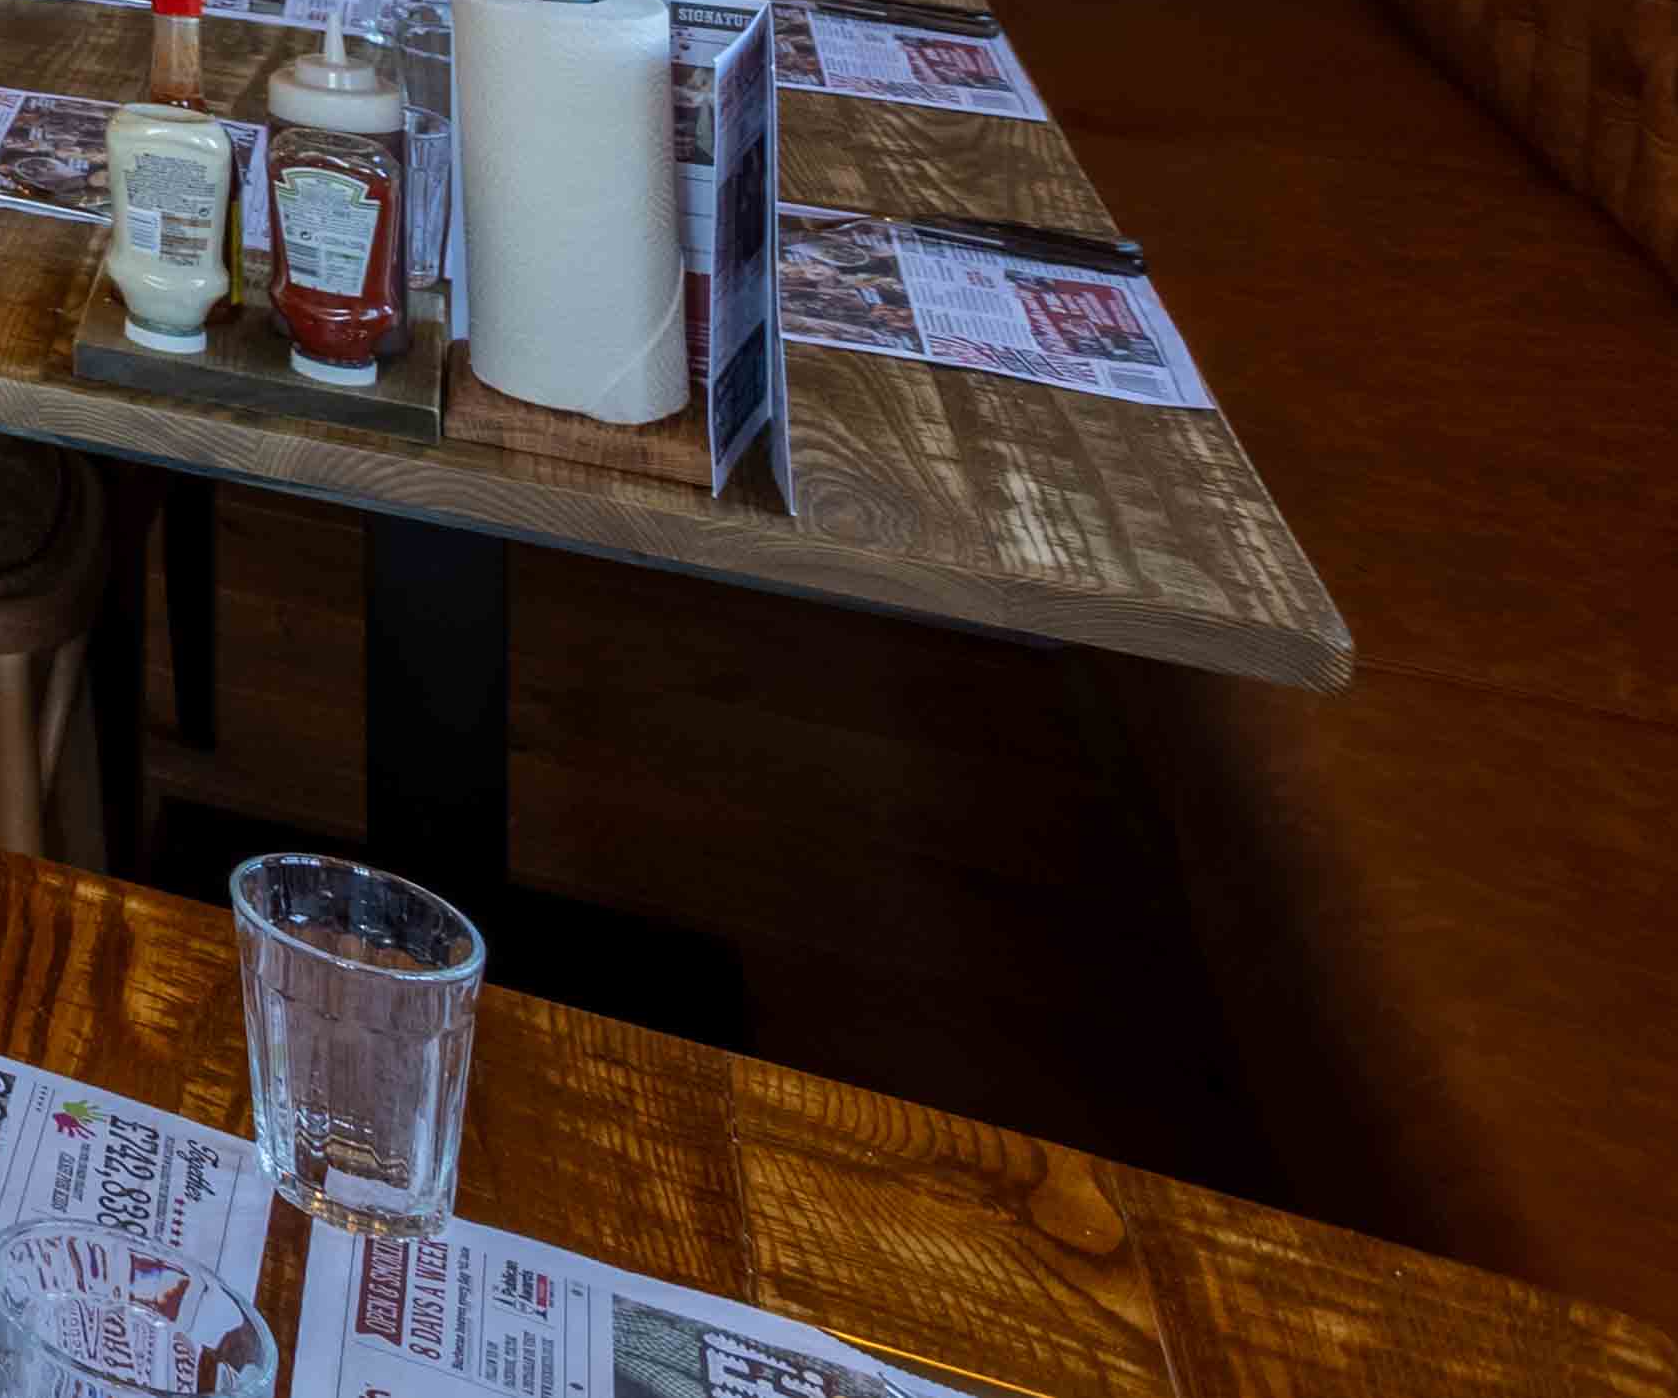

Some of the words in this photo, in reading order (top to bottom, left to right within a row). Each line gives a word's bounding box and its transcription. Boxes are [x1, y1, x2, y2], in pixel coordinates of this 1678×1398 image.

[678, 7, 744, 28] SIGNATU
[94, 1114, 160, 1239] £742,838
[175, 1138, 220, 1203] Together
[414, 1284, 446, 1297] A
[364, 1292, 398, 1334] OPEN
[410, 1297, 445, 1348] DAYS
[408, 1342, 441, 1361] 8
